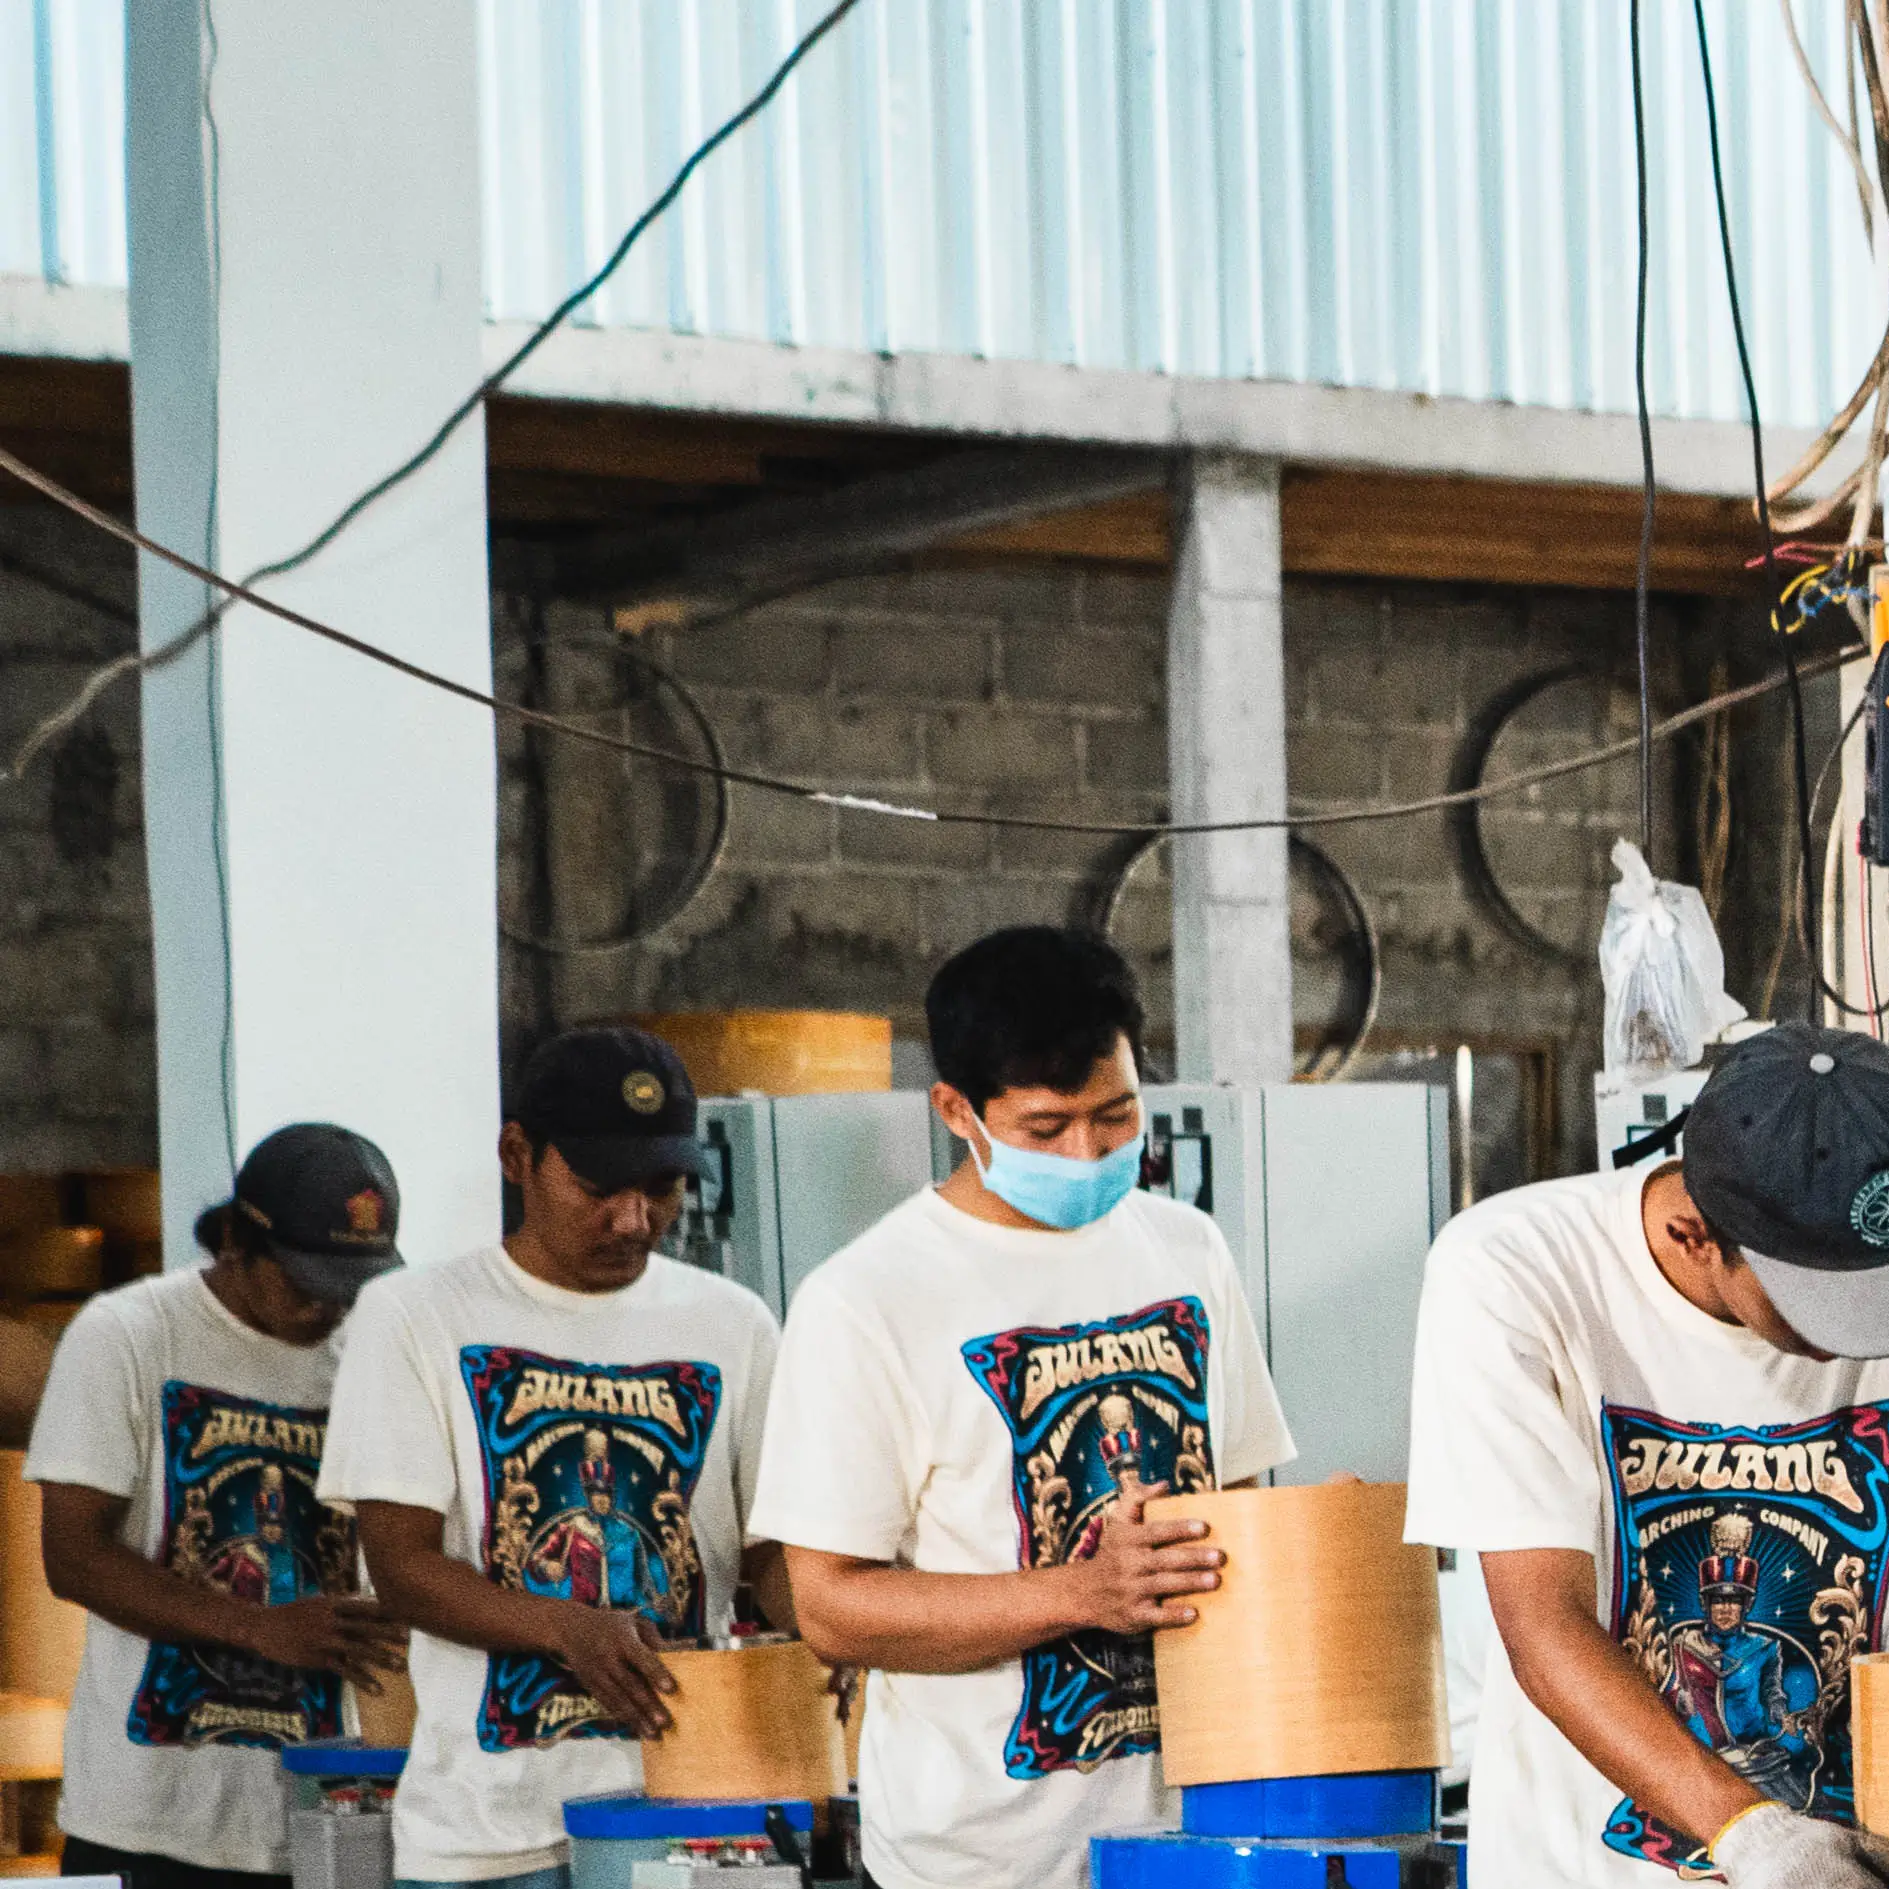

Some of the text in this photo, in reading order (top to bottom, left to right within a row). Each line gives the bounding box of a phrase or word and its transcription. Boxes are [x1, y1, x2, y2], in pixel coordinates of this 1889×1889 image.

[504, 1367, 687, 1439] JULANG
[1020, 1325, 1197, 1421] JULANG
[191, 1408, 328, 1460] JULAN
[1620, 1437, 1865, 1515] JULANG
[1638, 1505, 1830, 1567] ARCHING COMPANY
